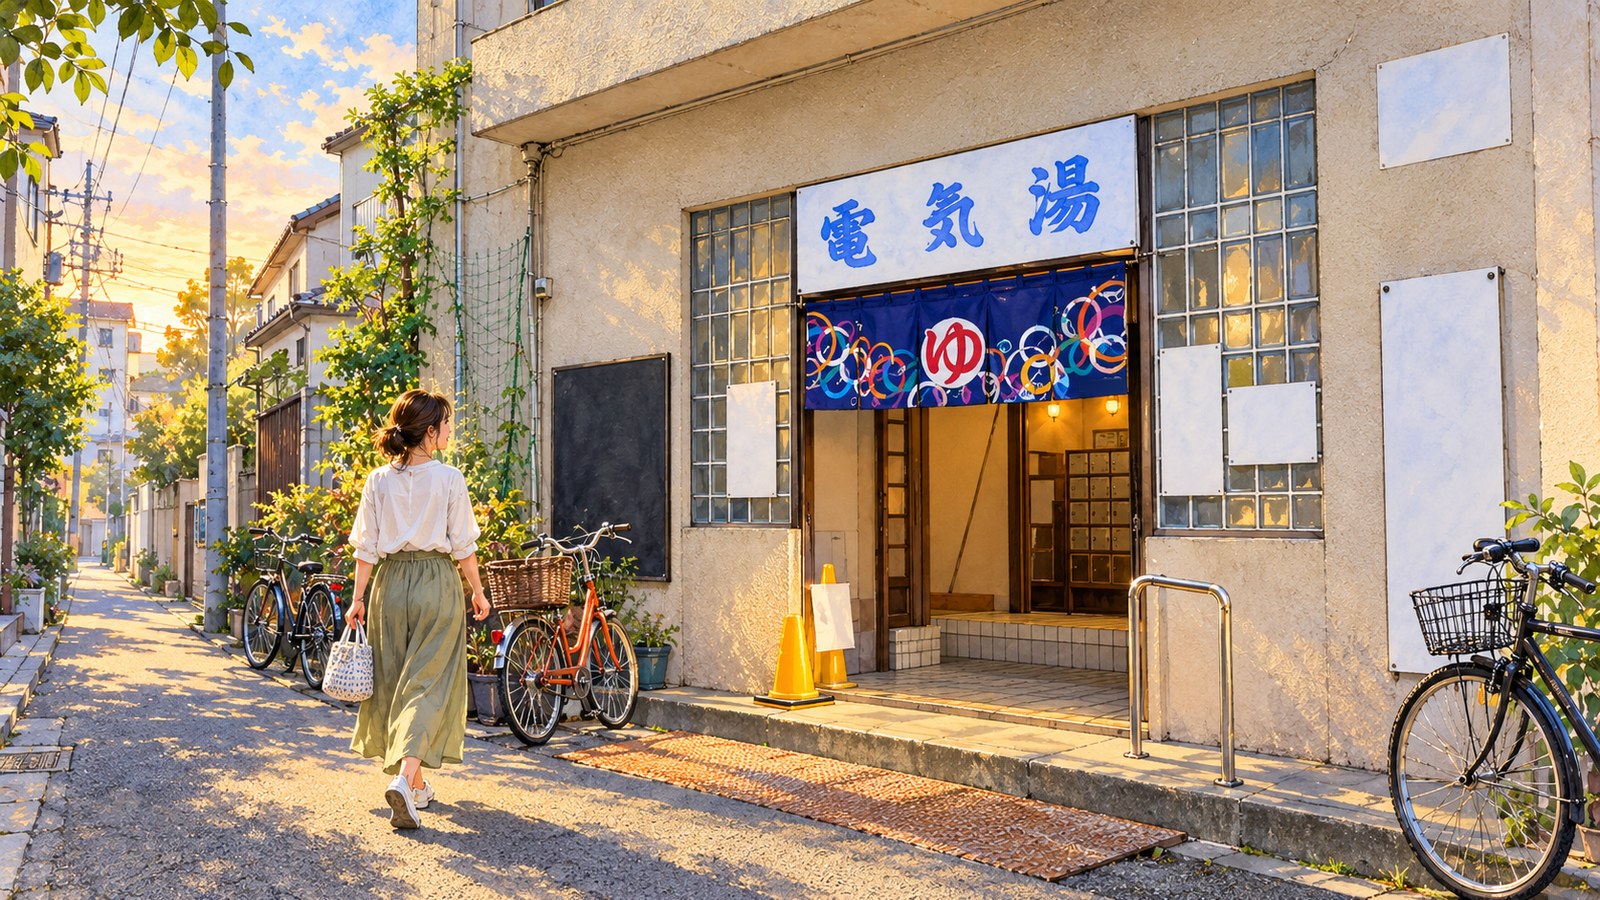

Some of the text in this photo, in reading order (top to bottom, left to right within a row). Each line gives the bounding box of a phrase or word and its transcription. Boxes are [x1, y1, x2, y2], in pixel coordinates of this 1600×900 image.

[821, 155, 1100, 268] 電気湯
[925, 322, 982, 385] ゆ
